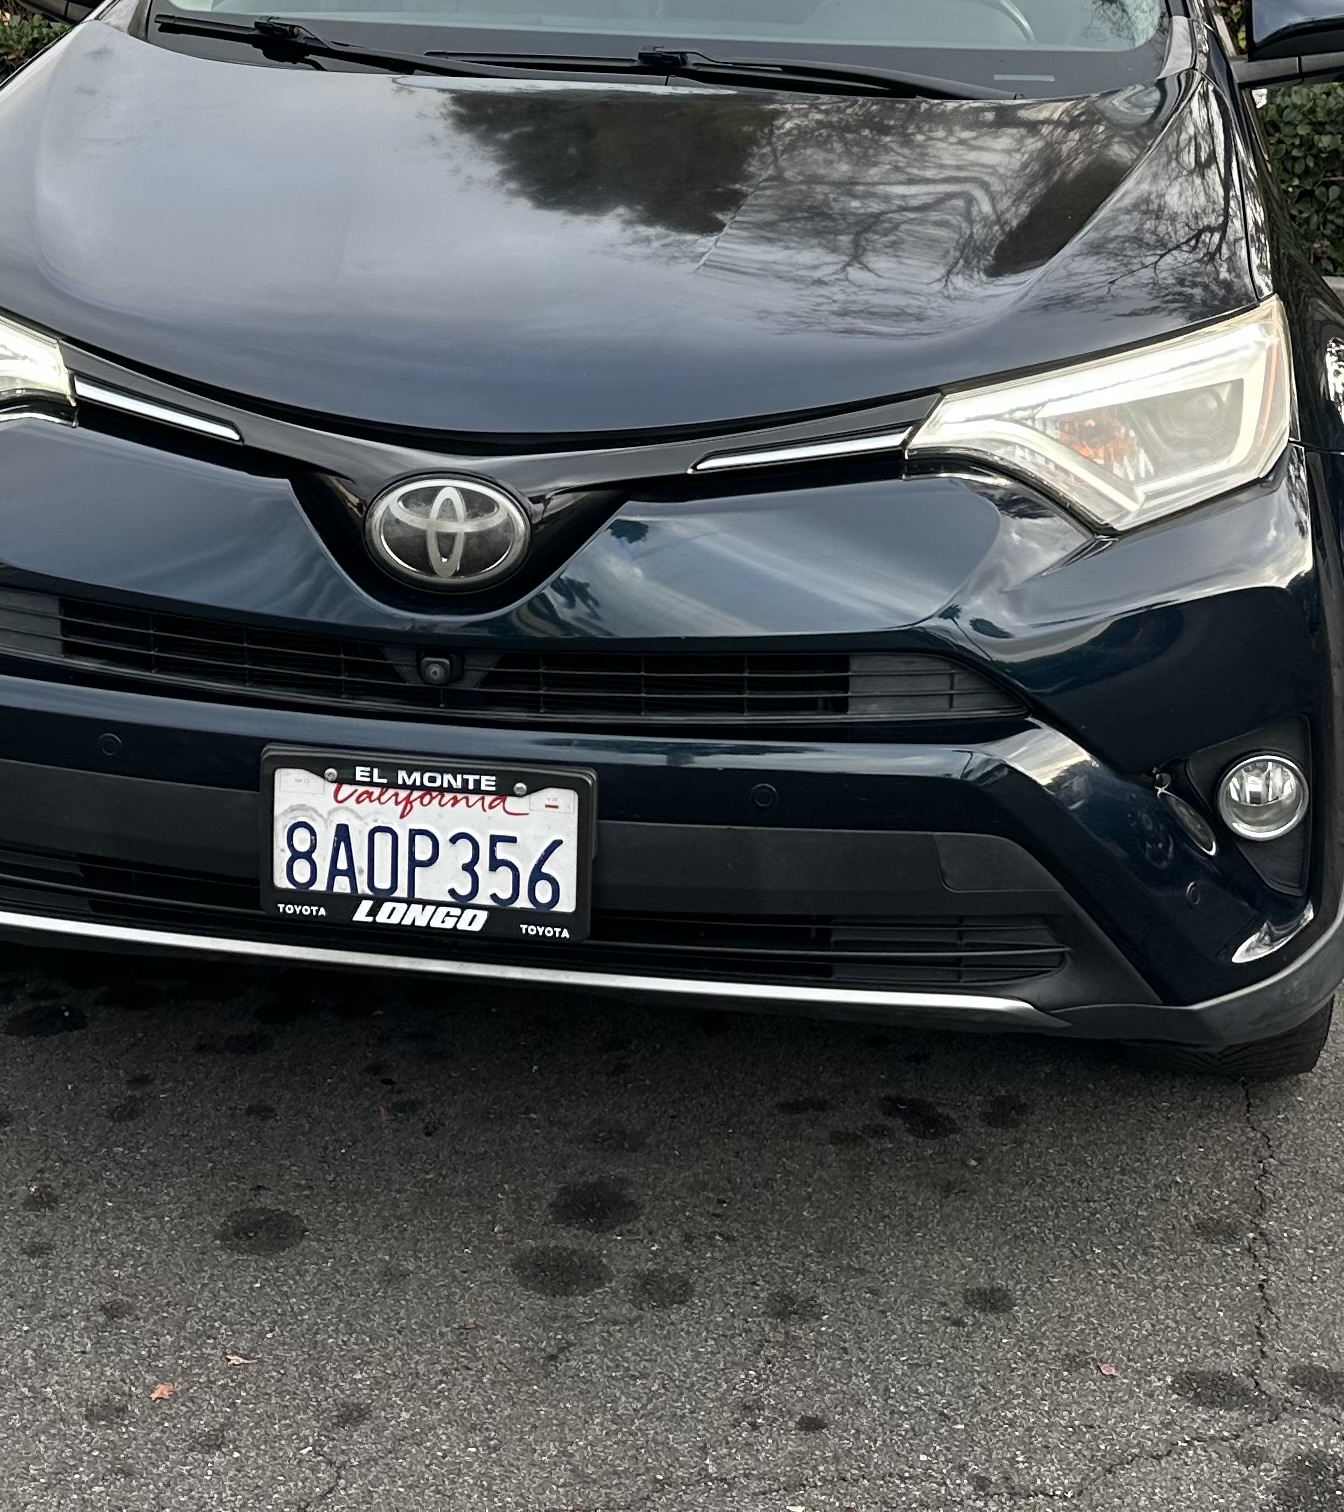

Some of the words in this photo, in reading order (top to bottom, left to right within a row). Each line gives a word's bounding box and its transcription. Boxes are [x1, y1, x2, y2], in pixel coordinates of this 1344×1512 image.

[355, 766, 388, 784] EL
[397, 769, 497, 791] MONTE
[333, 783, 529, 819] California
[277, 903, 327, 917] TOYOTA
[352, 899, 489, 932] LONGO
[519, 924, 570, 939] TOYOTA
